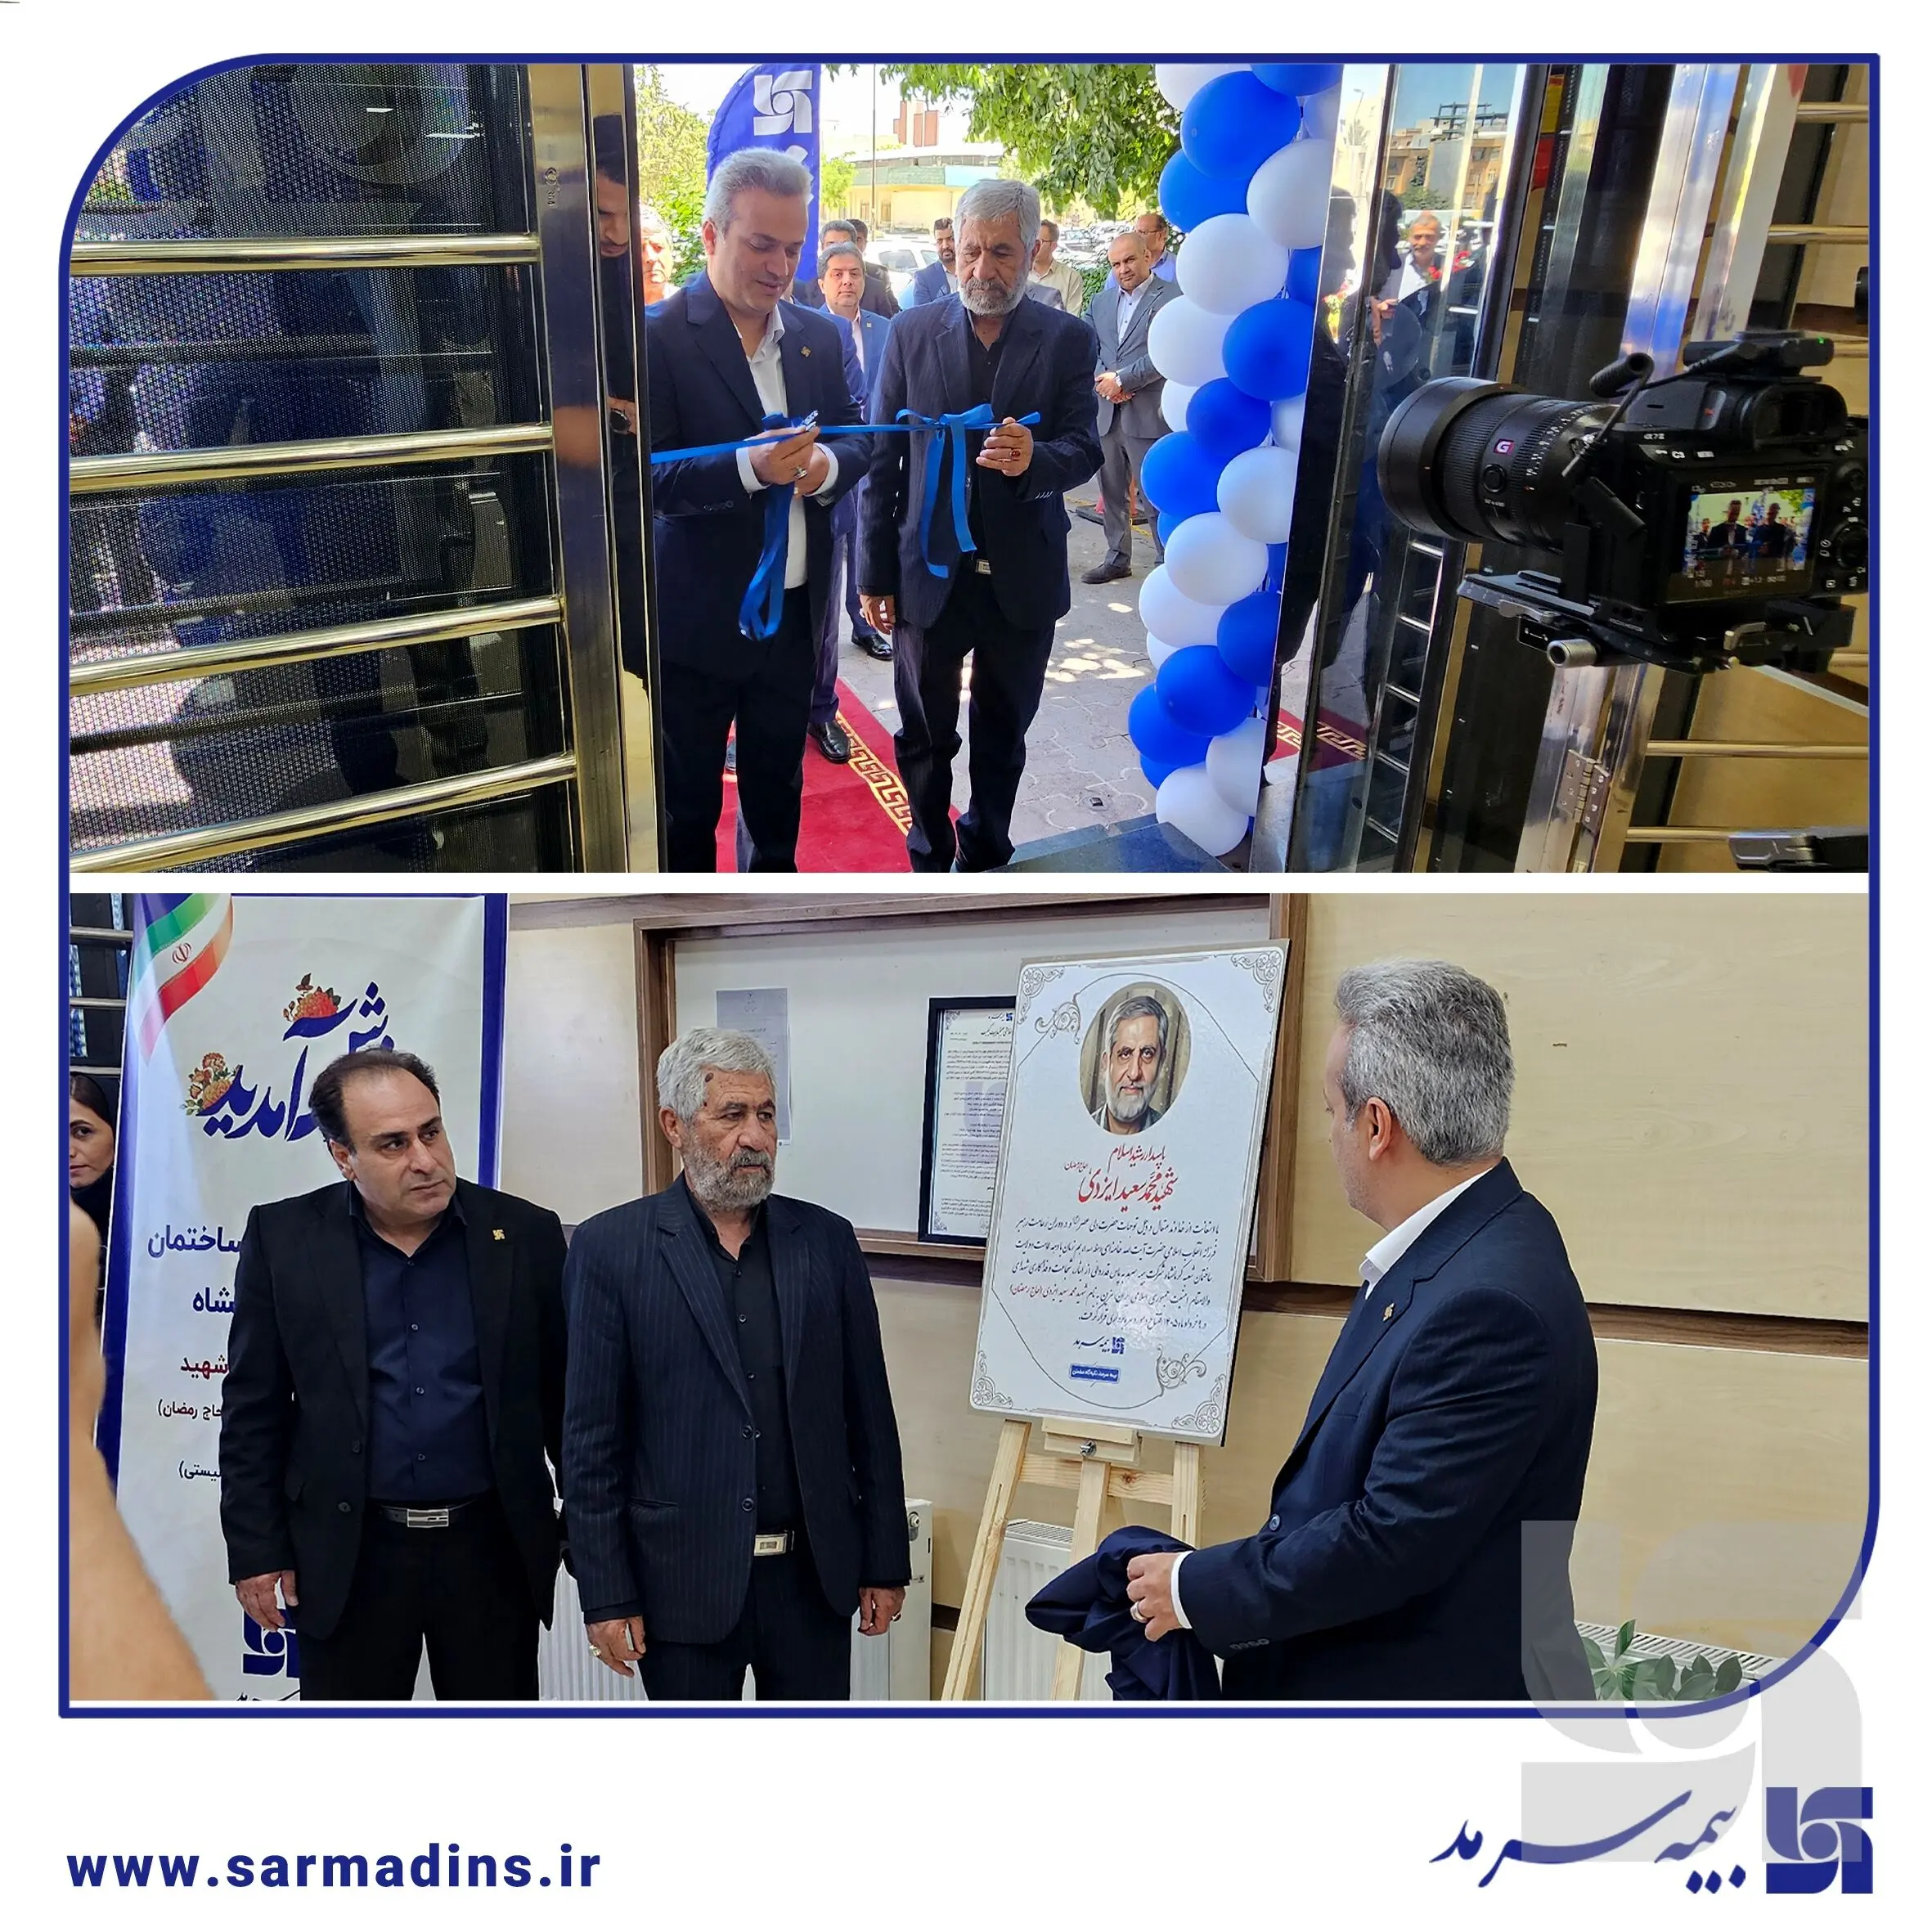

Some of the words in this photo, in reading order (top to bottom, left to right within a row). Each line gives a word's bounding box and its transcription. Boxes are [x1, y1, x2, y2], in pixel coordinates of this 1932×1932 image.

[1107, 1143, 1134, 1174] اسلام
[1128, 1145, 1146, 1168] رشید
[1144, 1144, 1166, 1170] پاسدار
[1077, 1168, 1120, 1203] ایزدی
[1113, 1180, 1147, 1212] سعید
[1147, 1166, 1179, 1211] شهید
[1098, 1217, 1119, 1233] حضرت
[148, 1224, 240, 1258] ساختمان
[1130, 1242, 1148, 1260] آیت
[1145, 1242, 1166, 1259] حضرت
[1163, 1246, 1182, 1260] اسلامی
[1182, 1242, 1202, 1262] انقلاب
[1145, 1260, 1167, 1282] شرکت
[1164, 1260, 1193, 1281] کرمانشاه
[1072, 1336, 1105, 1350] سرمد
[180, 1355, 229, 1380] شهید
[158, 1399, 199, 1419] رمضان)
[202, 1404, 222, 1421] حاج
